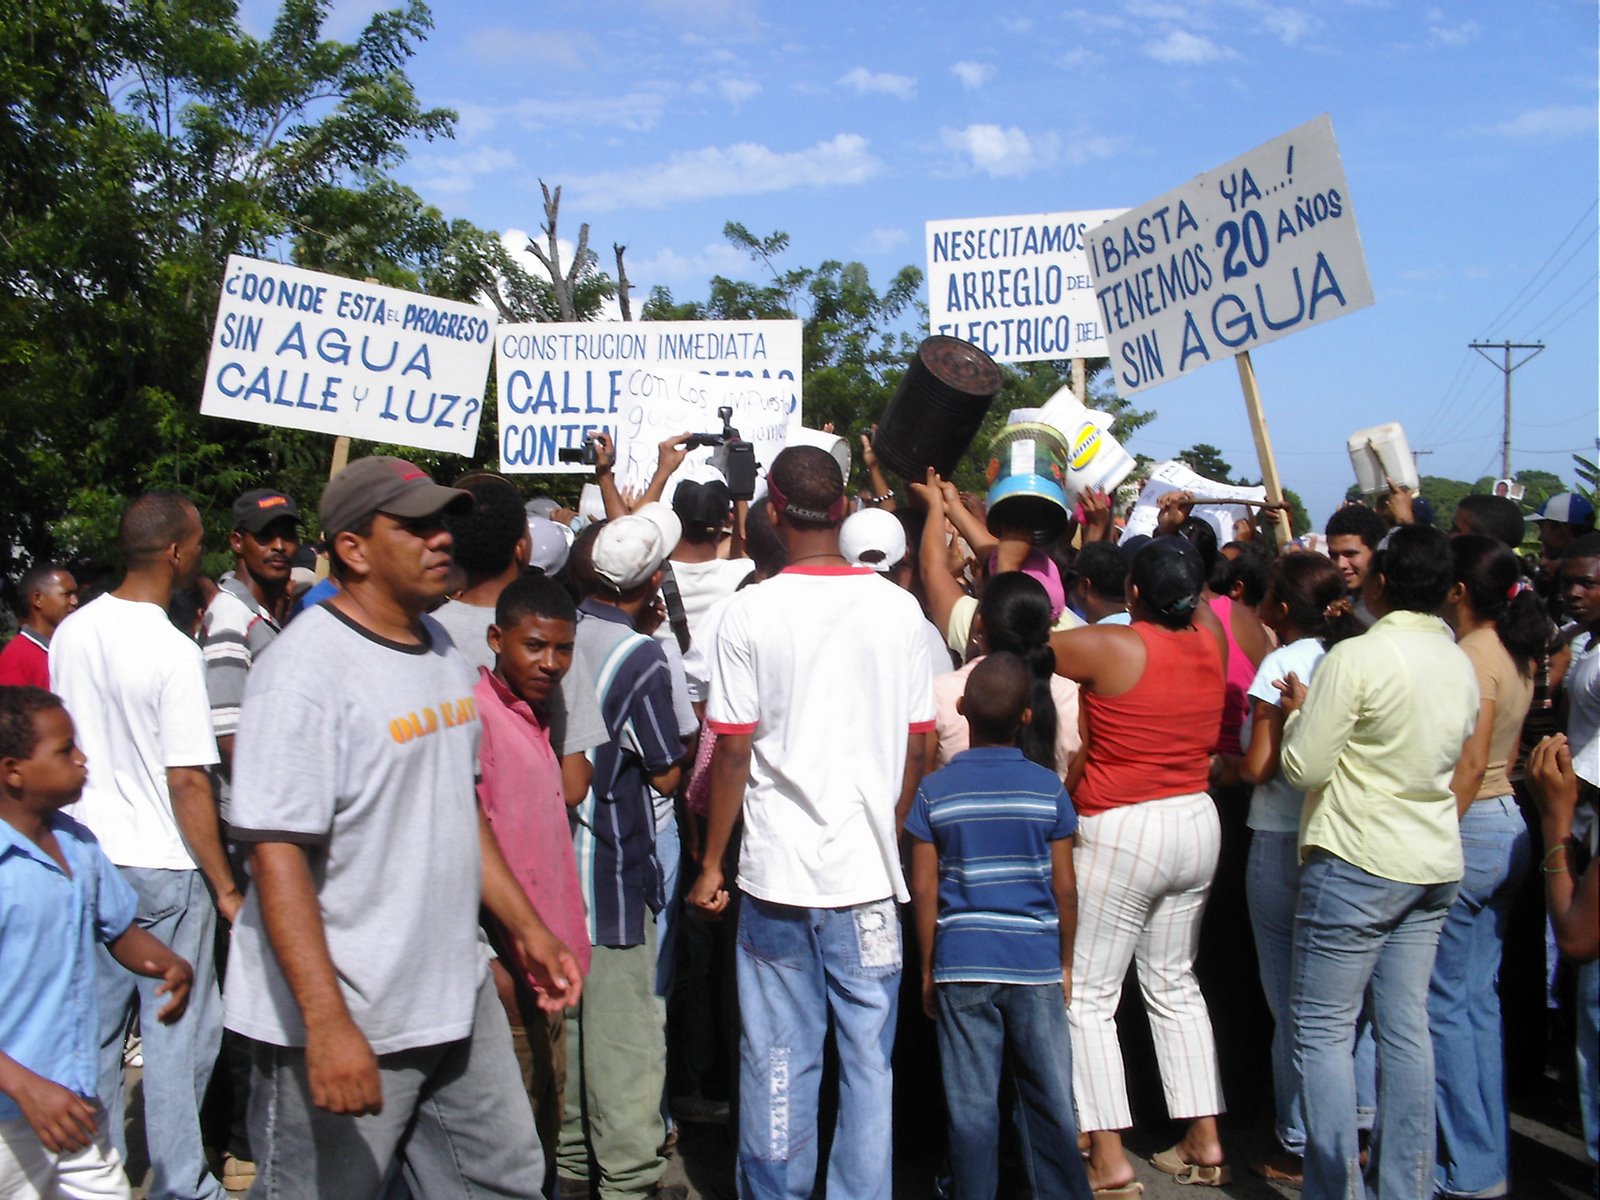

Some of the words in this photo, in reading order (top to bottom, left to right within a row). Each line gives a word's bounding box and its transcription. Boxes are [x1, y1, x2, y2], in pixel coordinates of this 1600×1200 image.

[934, 223, 1086, 262] NESECITAMOS
[1090, 200, 1199, 278] ¡BASTA
[1096, 243, 1213, 334] TENEMOS
[1215, 210, 1270, 282] 20
[1277, 188, 1342, 243] AÑOS
[226, 266, 327, 315] ¿DONDE
[337, 291, 385, 325] ESTA
[387, 309, 400, 322] EL
[402, 303, 489, 344] PROGRESO
[947, 264, 1062, 312] ARREGLO
[1067, 275, 1094, 290] DEL
[1122, 329, 1165, 388] SIN
[1179, 251, 1347, 372] AGUA
[220, 312, 263, 352] SIN
[275, 321, 432, 380] AGUA
[503, 333, 646, 360] CONSTRUCION
[657, 332, 767, 360] INMEDIATA
[1075, 322, 1104, 343] DEL
[216, 362, 342, 413] CALLE
[353, 385, 369, 412] Y
[380, 385, 480, 430] LUZ?
[388, 707, 438, 744] OLD
